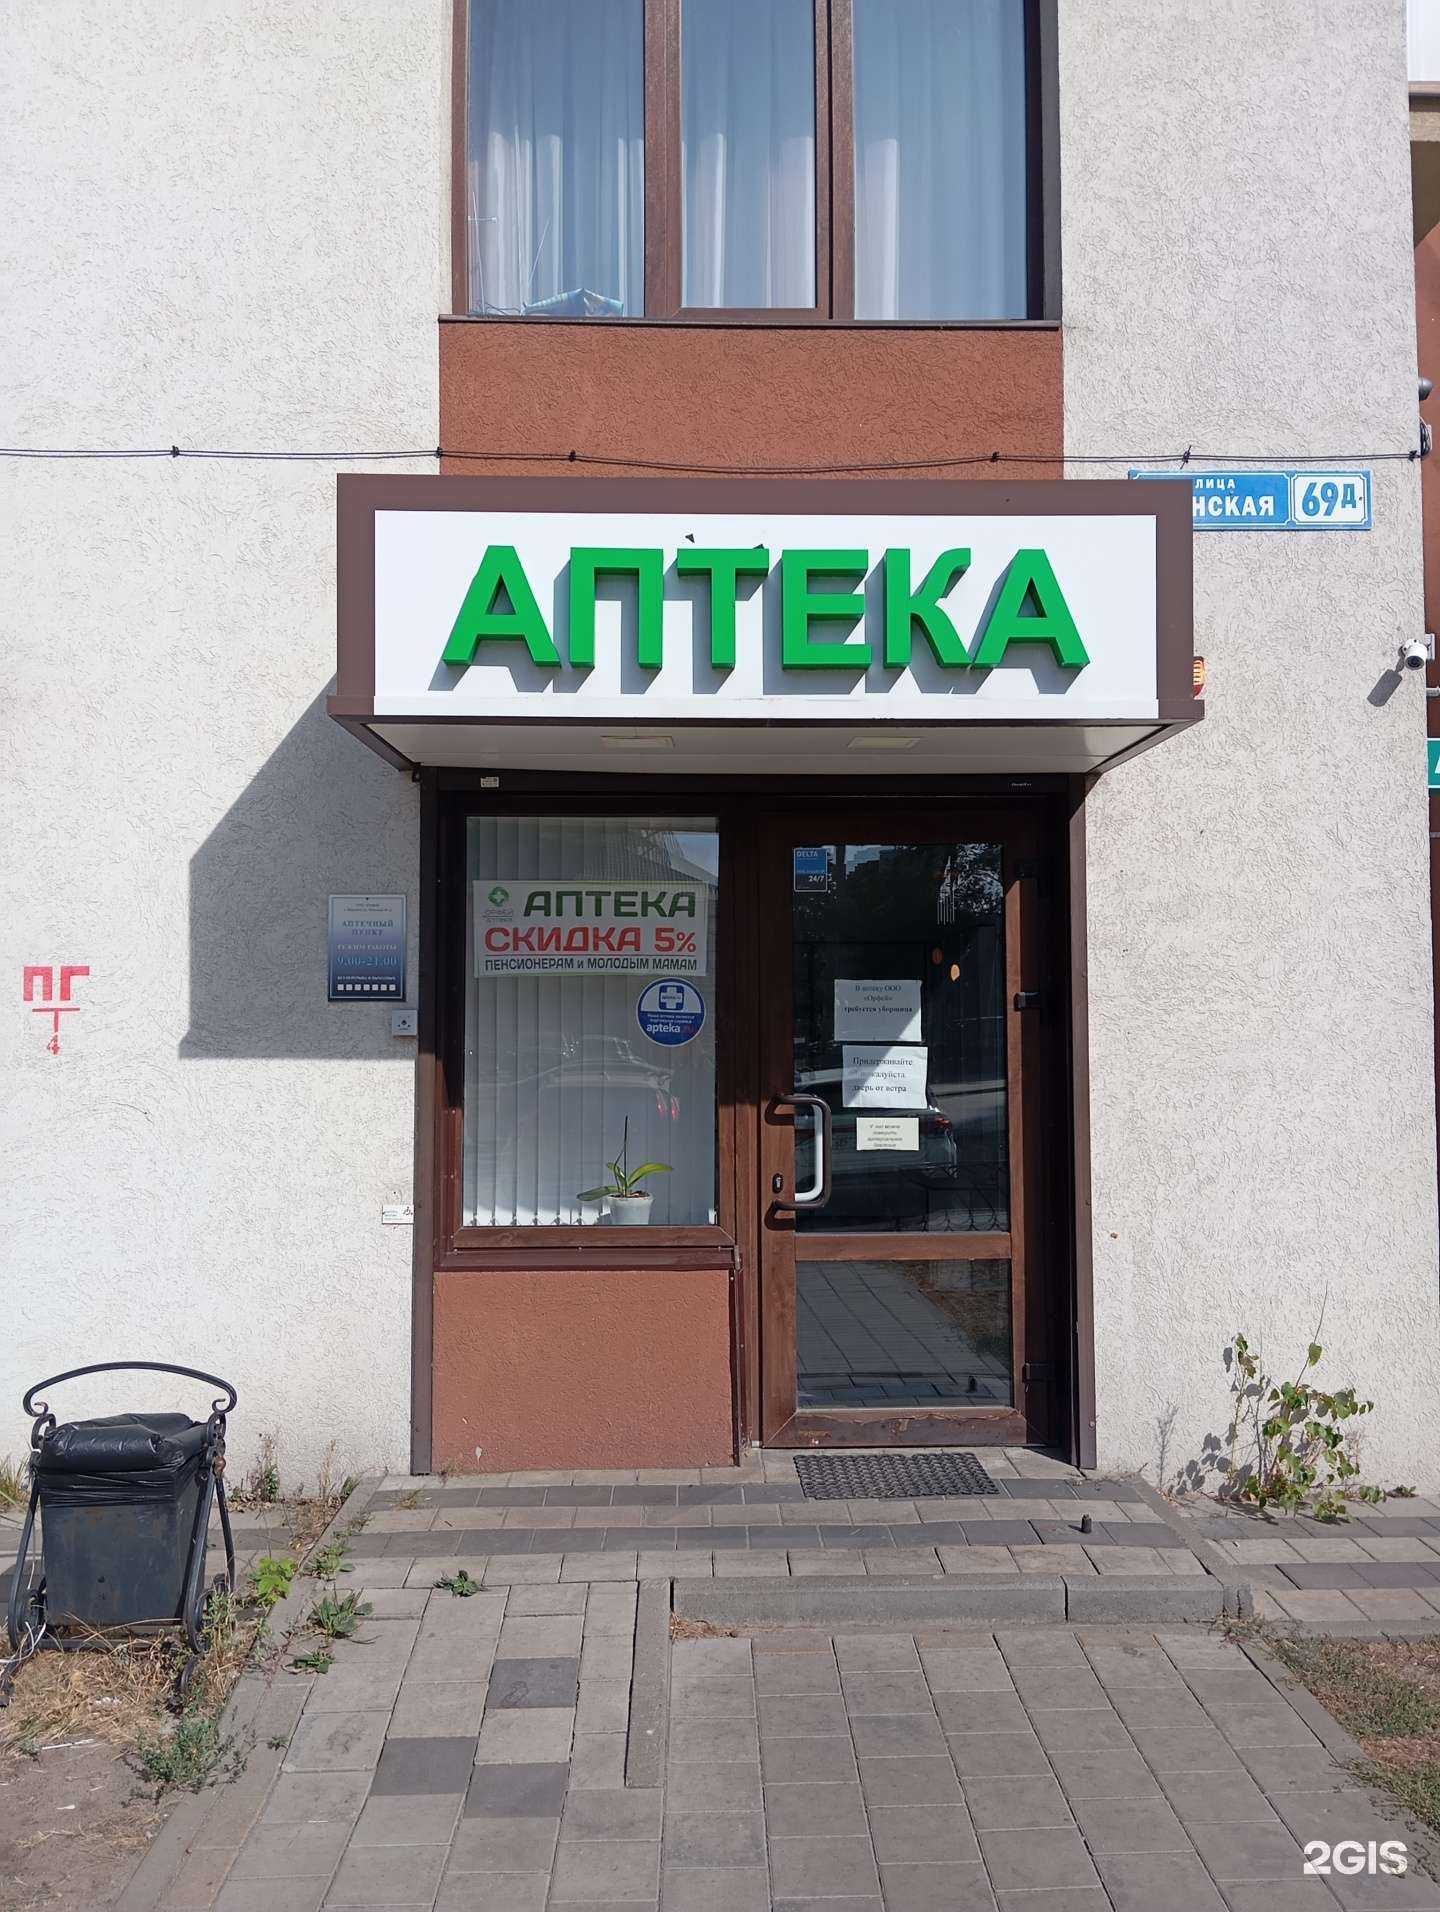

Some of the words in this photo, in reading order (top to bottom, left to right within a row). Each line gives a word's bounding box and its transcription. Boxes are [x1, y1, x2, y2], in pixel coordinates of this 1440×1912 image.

[1195, 478, 1236, 491] ЛИЦА
[1192, 495, 1275, 517] НСКАЯ
[442, 545, 1090, 670] АПТЕКА
[523, 890, 696, 918] АПТЕКА
[484, 926, 641, 952] СКИДКА
[654, 927, 697, 953] 5%
[485, 957, 574, 971] ПЕНСИОНЕРАМ
[587, 957, 649, 970] МОЛОДЫМ
[652, 958, 697, 971] МАМАМ
[23, 965, 90, 1001] ПГ
[646, 1022, 680, 1034] apteka
[860, 1071, 906, 1080] жалуйста
